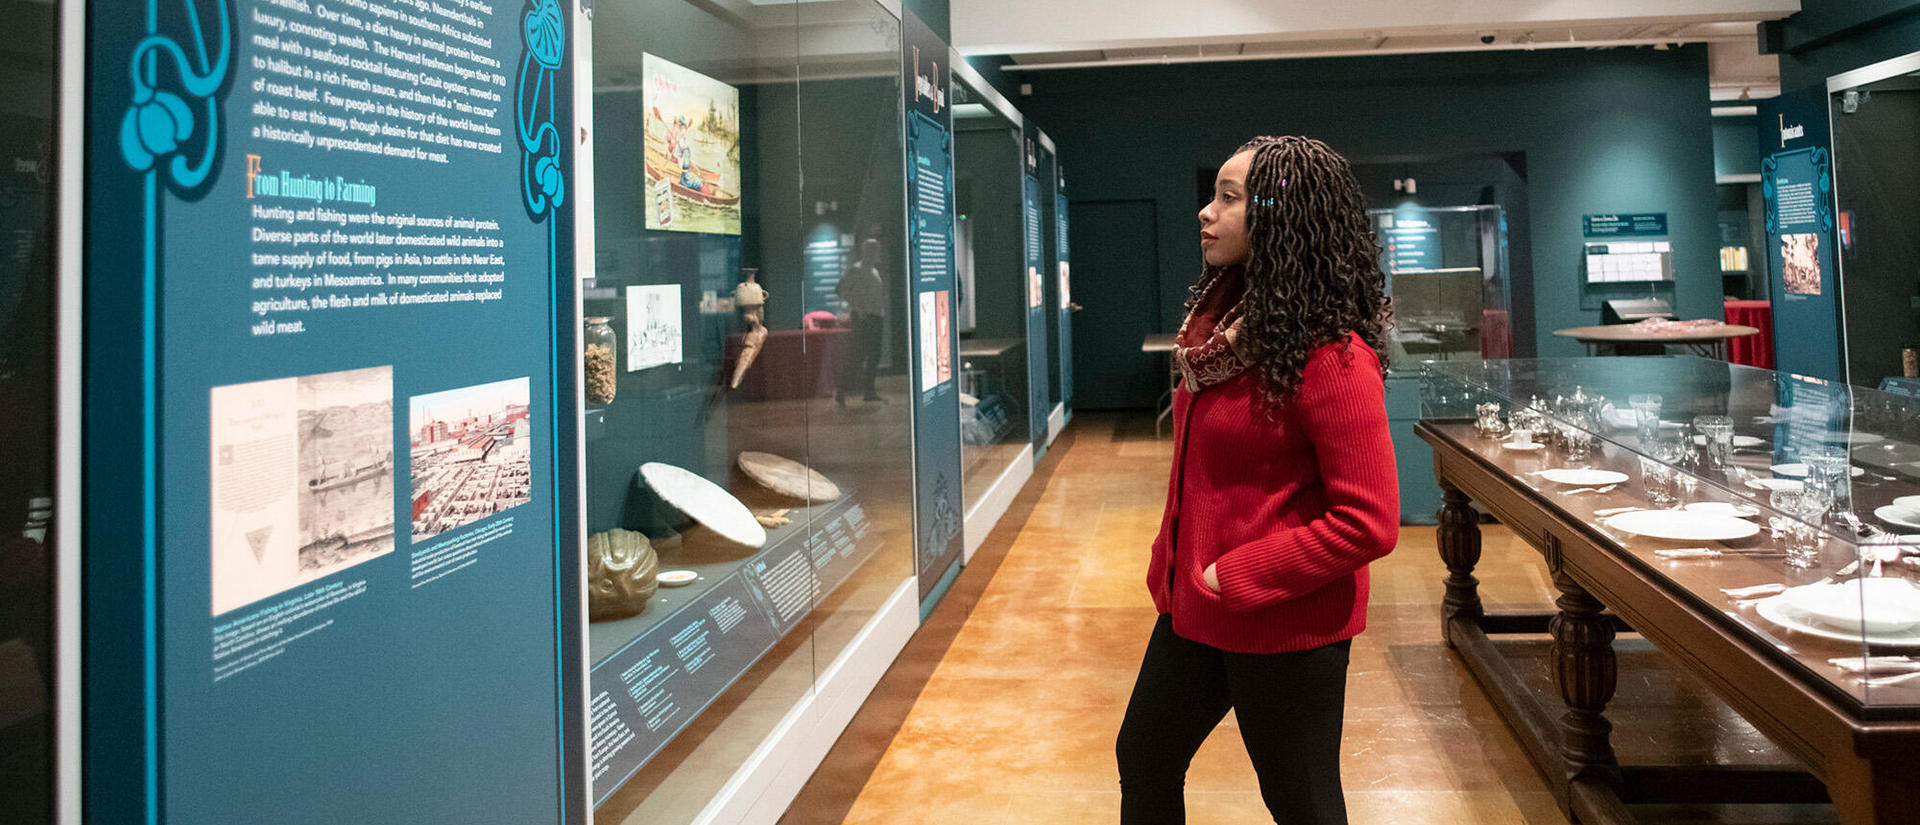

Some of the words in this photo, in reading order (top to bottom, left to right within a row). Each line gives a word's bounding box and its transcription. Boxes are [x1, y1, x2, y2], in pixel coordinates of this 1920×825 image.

[317, 4, 340, 22] Over
[341, 13, 363, 31] time,
[365, 22, 372, 31] a
[372, 21, 389, 36] diet
[389, 25, 413, 46] heavy
[413, 33, 421, 45] in
[422, 38, 445, 52] animal
[445, 46, 470, 60] protein
[470, 50, 496, 67] became
[496, 60, 501, 68] a
[369, 3, 399, 19] sapiens
[400, 10, 408, 22] in
[408, 15, 440, 32] southern
[441, 24, 461, 39] Africa
[461, 31, 492, 48] subsisted
[432, 1, 477, 27] Neanderthals
[477, 17, 484, 29] in
[253, 34, 280, 50] meal
[281, 40, 303, 56] with
[304, 47, 311, 58] a
[312, 48, 350, 67] seafood
[351, 57, 383, 74] cocktail
[383, 62, 419, 86] featuring
[420, 73, 442, 89] Cotuit
[443, 81, 469, 96] oysters,
[470, 87, 492, 100] moved
[492, 93, 501, 102] on
[254, 7, 288, 33] luxury,
[289, 21, 337, 46] connoting
[338, 35, 370, 51] wealth.
[374, 40, 389, 56] The
[390, 46, 421, 65] Harvard
[421, 53, 454, 73] freshman
[454, 62, 476, 80] began
[476, 69, 491, 83] their
[492, 73, 506, 87] 1910
[253, 78, 266, 91] of
[267, 83, 293, 98] roast
[295, 84, 321, 102] beef.
[324, 90, 345, 107] Few
[345, 99, 376, 115] people
[377, 102, 385, 114] in
[386, 103, 399, 117] the
[400, 106, 427, 125] history
[427, 112, 436, 124] of
[436, 114, 449, 127] the
[449, 118, 468, 130] world
[469, 120, 484, 133] have
[485, 122, 501, 136] been
[254, 56, 266, 69] to
[267, 57, 302, 77] halibut
[304, 66, 314, 79] in
[315, 71, 321, 81] a
[322, 71, 340, 85] rich
[341, 73, 371, 91] French
[372, 83, 397, 98] sauce,
[398, 88, 414, 101] and
[415, 90, 432, 104] then
[432, 93, 446, 109] had
[447, 100, 452, 109] a
[453, 99, 473, 113] "main
[473, 106, 497, 118] course"
[253, 99, 277, 117] able
[278, 106, 290, 119] to
[291, 111, 308, 122] eat
[309, 110, 327, 125] this
[328, 117, 349, 132] way,
[350, 117, 380, 136] though
[381, 122, 406, 138] desire
[407, 126, 418, 139] for
[420, 128, 434, 142] that
[435, 132, 449, 145] diet
[450, 134, 462, 147] has
[463, 139, 478, 149] now
[478, 142, 502, 153] created
[253, 127, 260, 138] a
[261, 123, 315, 149] historically
[316, 136, 383, 154] unprecedented
[384, 142, 416, 158] demand
[417, 147, 428, 160] for
[428, 153, 450, 163] meat.
[246, 153, 279, 198] From
[281, 170, 323, 204] Hunting
[324, 177, 335, 200] to
[336, 175, 376, 207] Farming
[253, 204, 295, 223] Hunting
[296, 207, 315, 221] and
[316, 207, 347, 226] fishing
[348, 213, 370, 224] were
[371, 212, 386, 224] the
[387, 213, 416, 229] original
[416, 217, 444, 228] sources
[445, 216, 453, 228] of
[453, 217, 475, 229] animal
[475, 219, 500, 232] protein.
[253, 227, 293, 241] Diverse
[293, 230, 319, 247] parts
[320, 229, 332, 243] of
[332, 230, 348, 243] the
[349, 231, 375, 244] world
[375, 231, 395, 245] later
[395, 233, 446, 246] domesticated
[446, 235, 460, 246] wild
[461, 236, 485, 247] animals
[486, 237, 499, 247] into
[499, 239, 504, 248] a
[252, 253, 280, 265] tame
[282, 250, 315, 269] supply
[316, 251, 327, 265] of
[328, 251, 353, 267] food,
[353, 251, 375, 264] from
[375, 253, 393, 269] pigs
[394, 253, 402, 264] in
[403, 253, 422, 266] Asia,
[422, 254, 432, 265] to
[432, 253, 453, 265] cattle
[453, 253, 460, 264] in
[460, 253, 472, 265] the
[473, 254, 489, 265] Near
[489, 254, 505, 266] East,
[252, 274, 273, 288] and
[274, 273, 312, 291] turkeys
[313, 274, 322, 286] in
[323, 273, 384, 286] Mesoamerica.
[387, 272, 396, 285] In
[397, 275, 419, 288] many
[419, 272, 463, 284] communities
[463, 271, 477, 283] that
[478, 271, 504, 285] adopted
[252, 296, 311, 316] agriculture,
[311, 295, 328, 309] the
[329, 294, 352, 308] flesh
[352, 293, 370, 306] and
[370, 292, 388, 306] milk
[389, 292, 399, 305] of
[399, 290, 449, 304] domesticated
[449, 289, 474, 302] animals
[475, 288, 502, 303] replaced
[252, 320, 275, 335] wild
[276, 320, 306, 334] meat.
